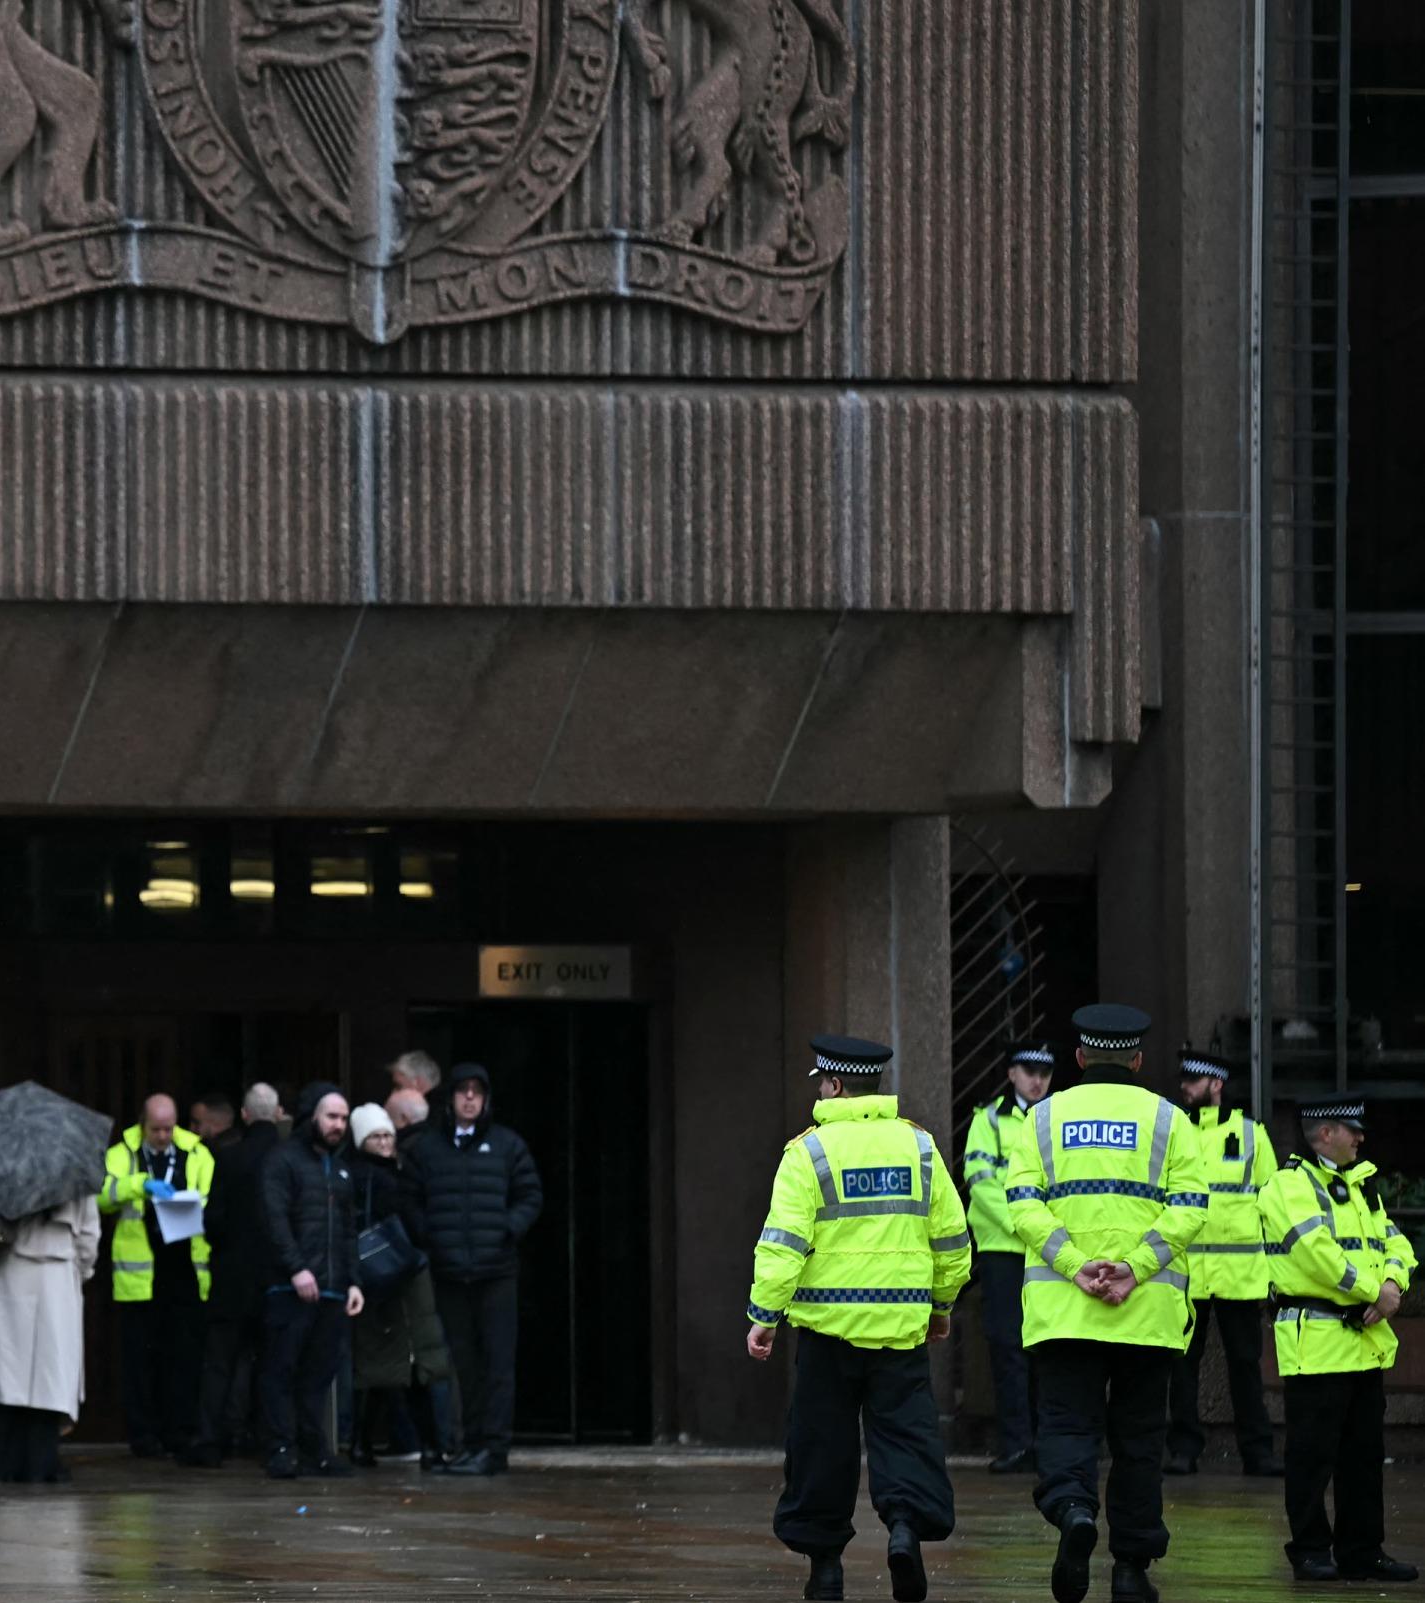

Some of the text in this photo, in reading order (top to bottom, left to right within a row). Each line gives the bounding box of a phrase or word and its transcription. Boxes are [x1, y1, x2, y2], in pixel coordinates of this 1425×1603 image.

[154, 80, 254, 214] HONI
[508, 45, 609, 213] PENSE
[199, 247, 284, 303] ET
[435, 246, 586, 314] MON
[630, 246, 823, 323] DROIT
[497, 962, 611, 982] EXIT ONLY
[1063, 1123, 1134, 1145] POLICE
[845, 1170, 911, 1194] POLICE
